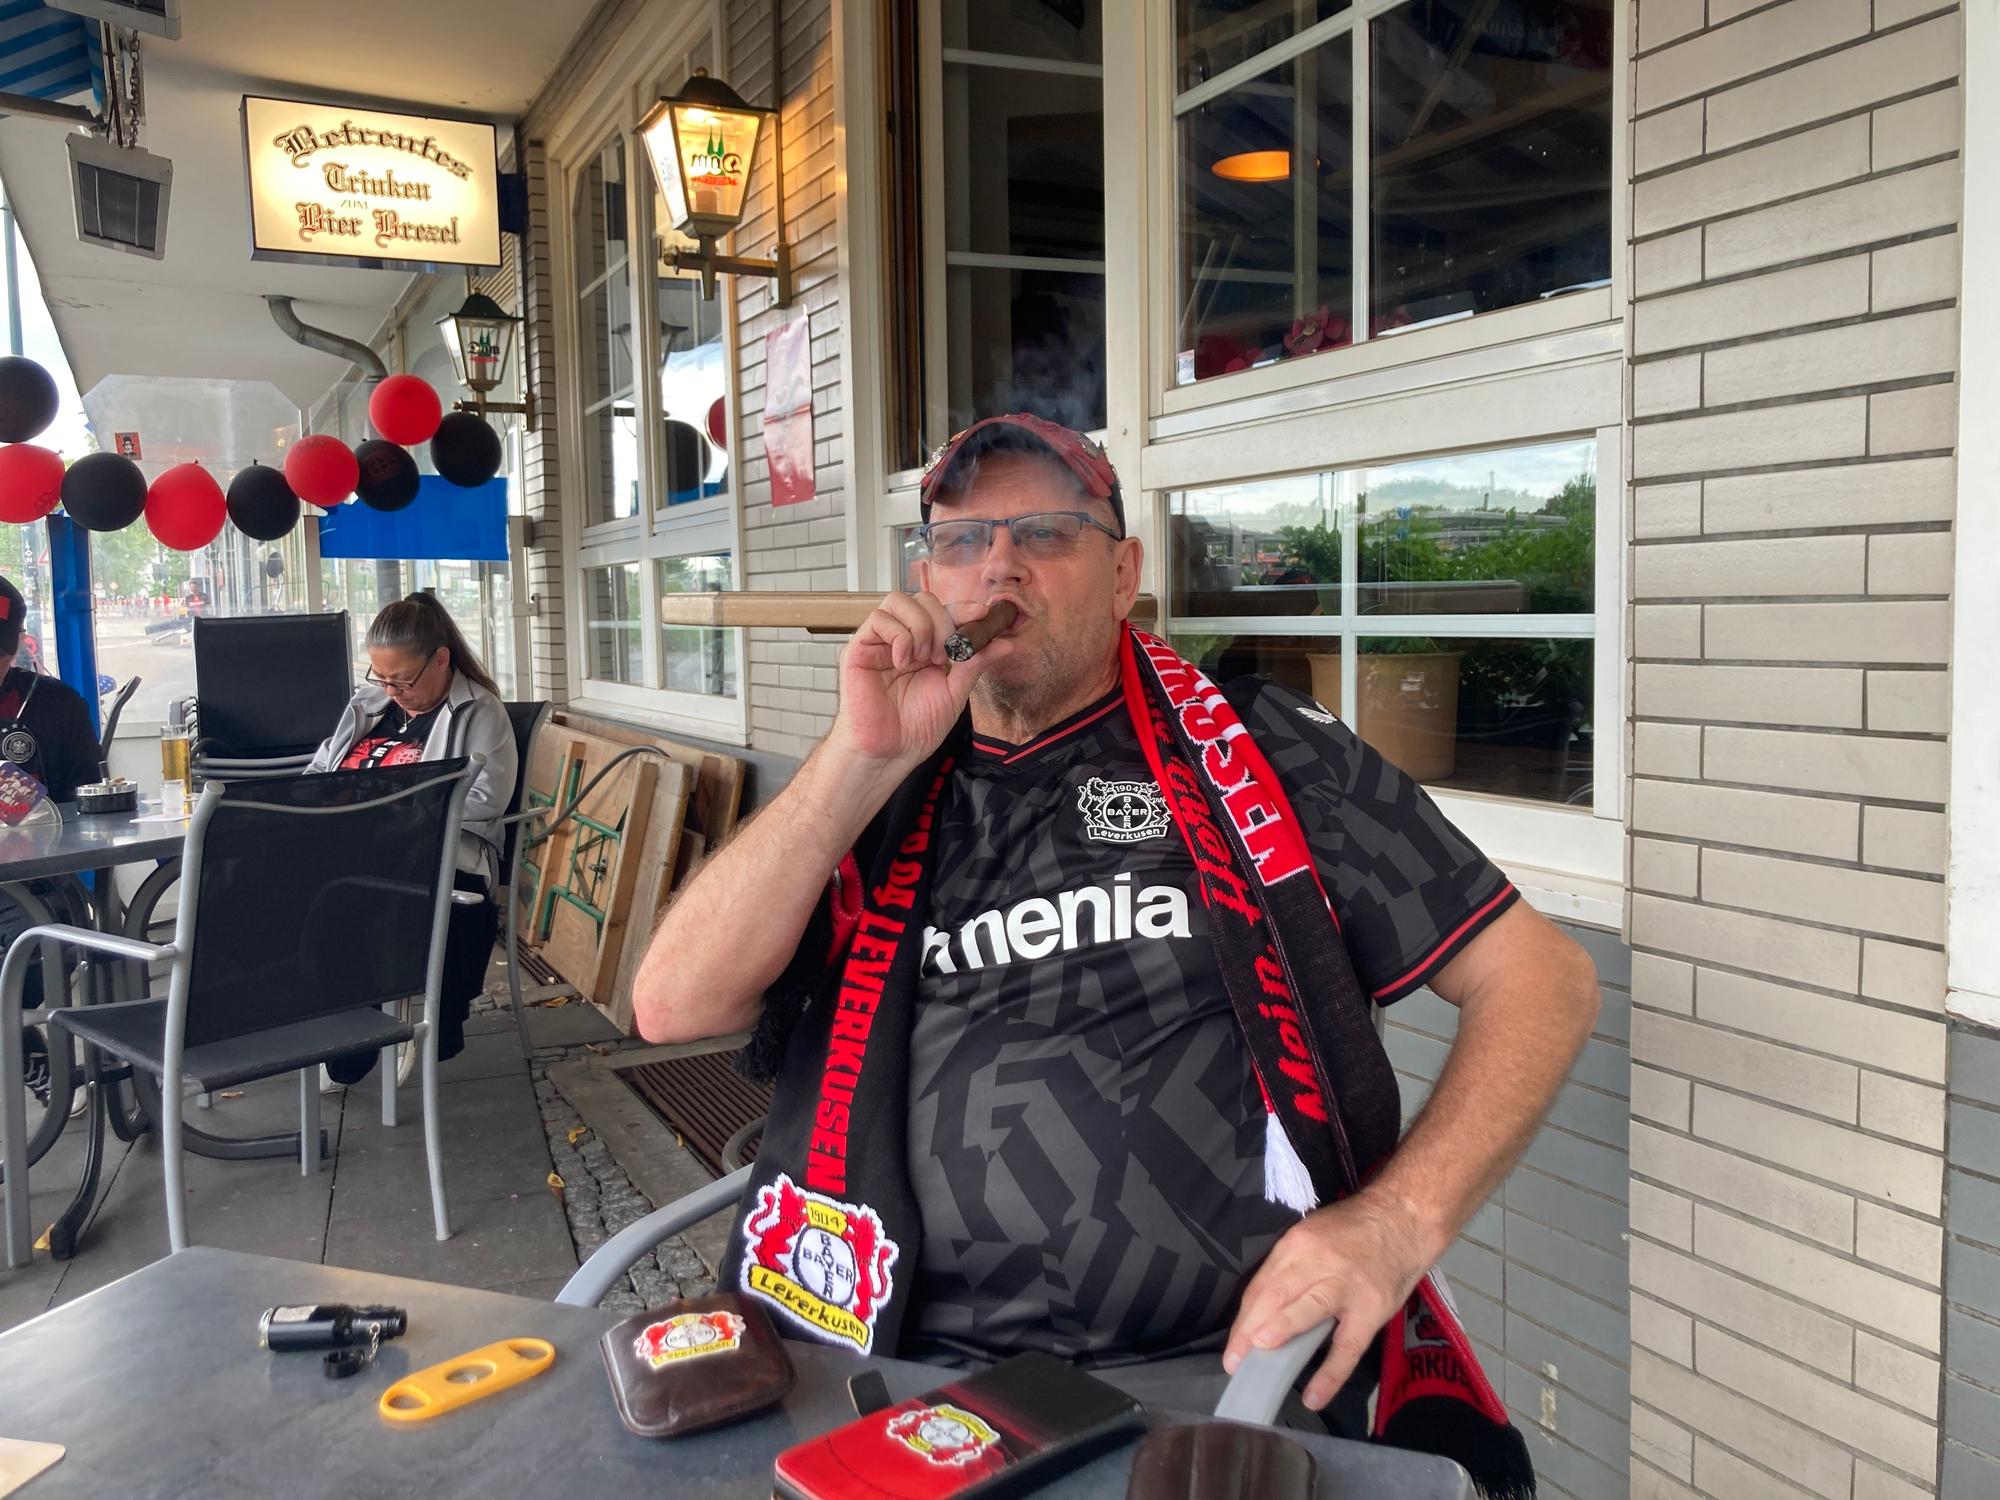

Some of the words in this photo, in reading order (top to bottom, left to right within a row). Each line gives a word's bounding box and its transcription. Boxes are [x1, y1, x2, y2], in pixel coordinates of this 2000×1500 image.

[322, 162, 432, 201] Trinken
[296, 201, 363, 243] Bier
[373, 208, 461, 248] Brezel
[1115, 785, 1138, 793] 1904
[1107, 808, 1148, 816] BAYER
[1123, 796, 1132, 829] BAYER
[1094, 828, 1160, 840] Leverkusen
[807, 909, 906, 1194] LEVERKUSEN
[802, 1248, 853, 1284] BAYER
[820, 1232, 834, 1299] BAYER
[760, 1273, 864, 1341] Leverkusen
